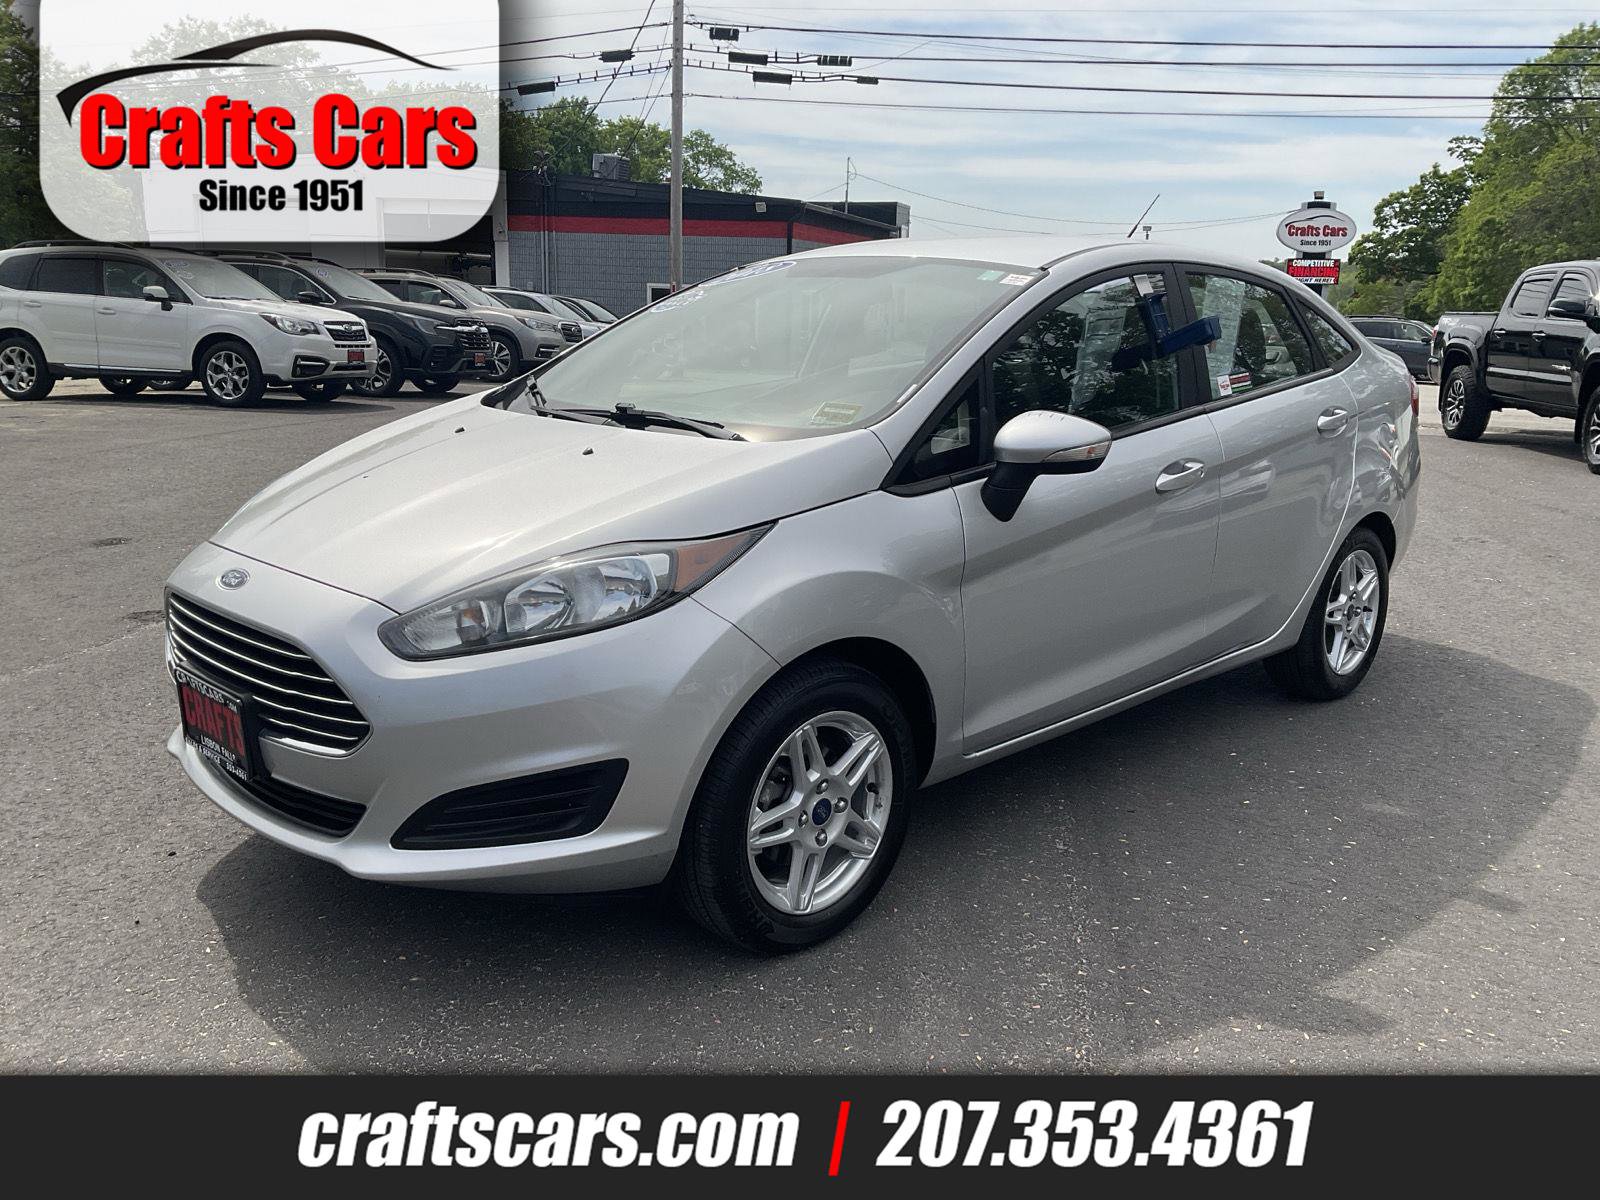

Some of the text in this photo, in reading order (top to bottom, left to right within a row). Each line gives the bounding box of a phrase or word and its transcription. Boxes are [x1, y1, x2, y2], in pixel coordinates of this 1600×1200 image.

[1288, 224, 1348, 237] Crafts Cars
[1293, 259, 1335, 267] COMPETITIVE
[1289, 267, 1338, 277] FINANCING
[180, 682, 246, 758] CRAFTS
